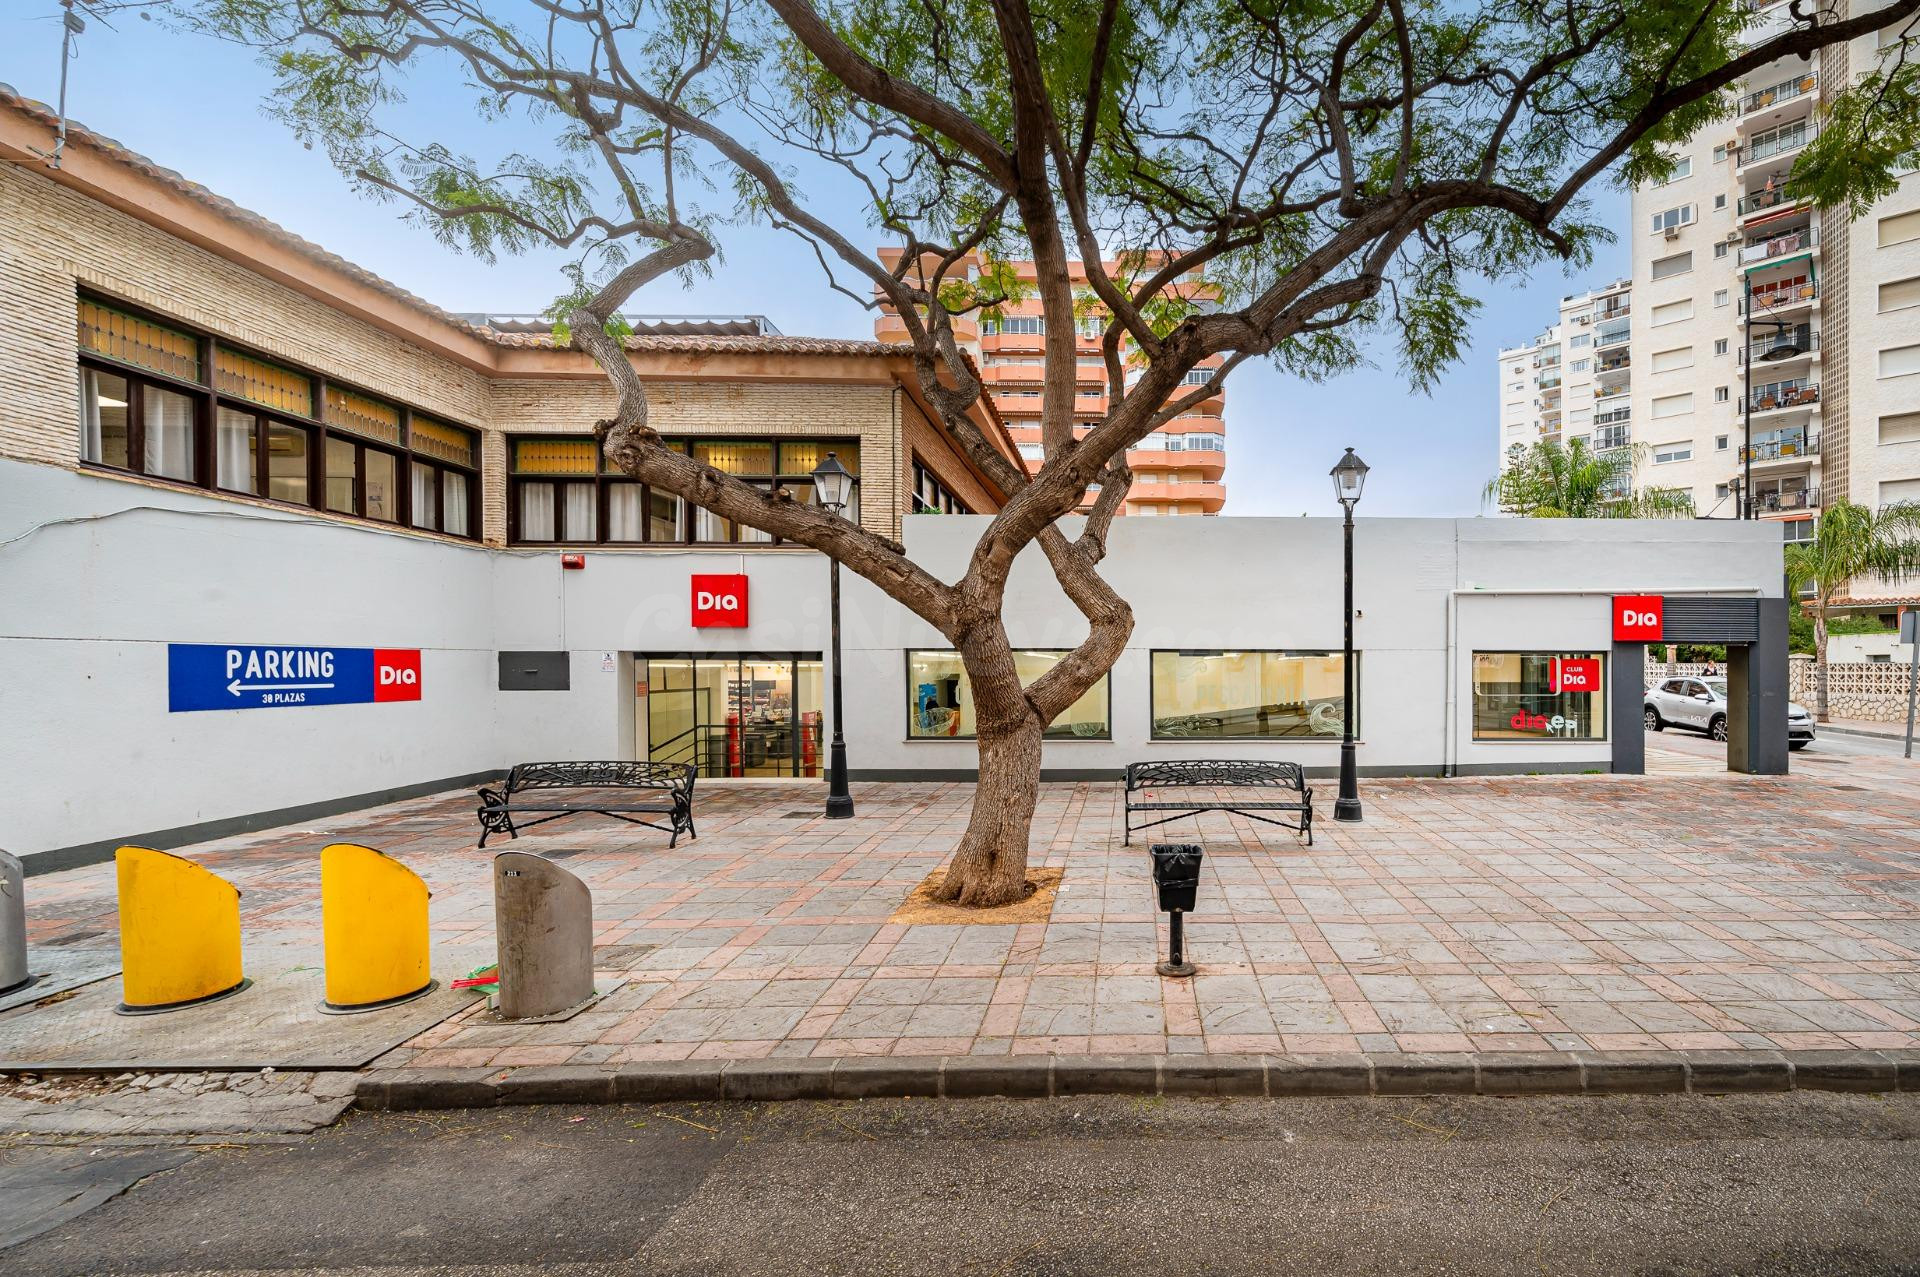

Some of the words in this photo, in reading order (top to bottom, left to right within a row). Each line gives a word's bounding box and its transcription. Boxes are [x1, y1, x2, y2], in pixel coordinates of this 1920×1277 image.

[226, 649, 334, 679] PARKING
[262, 694, 273, 704] 38
[274, 692, 306, 703] PLAZAS
